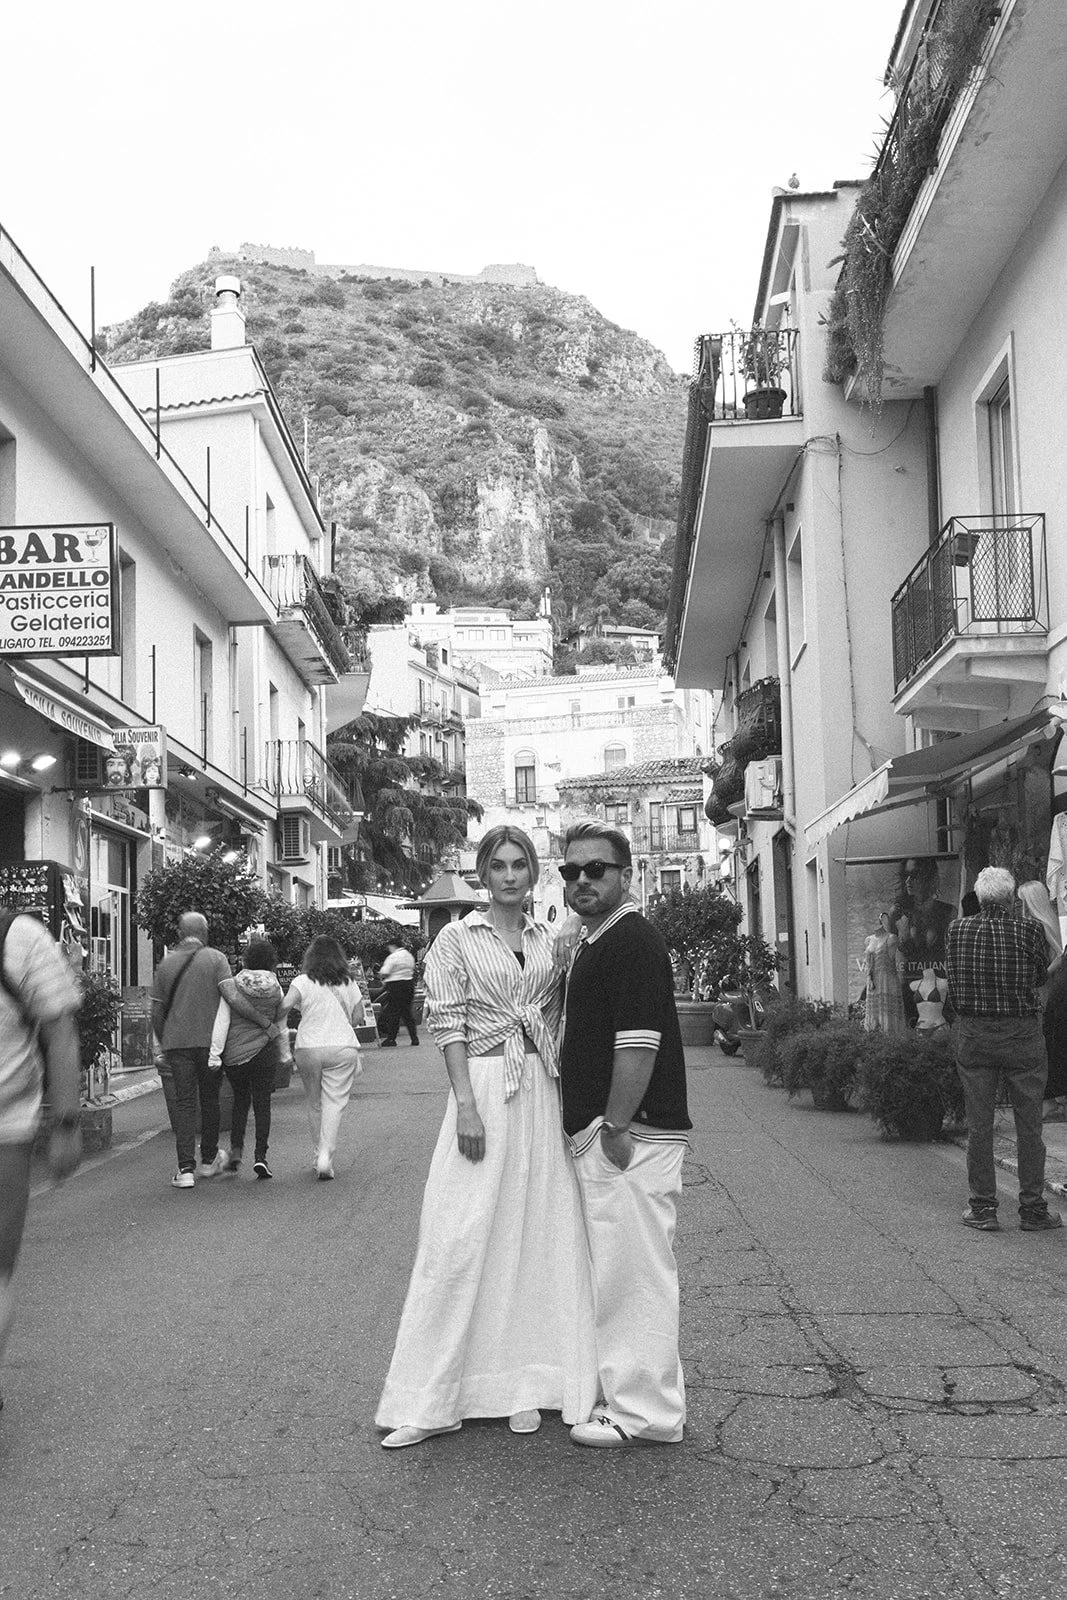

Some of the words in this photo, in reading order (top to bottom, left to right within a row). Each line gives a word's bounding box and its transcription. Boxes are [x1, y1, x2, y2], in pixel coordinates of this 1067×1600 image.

[0, 532, 84, 564] BAR
[10, 612, 109, 632] Gelateria
[39, 636, 56, 648] TEL.
[58, 634, 110, 648] 094223251
[25, 688, 56, 720] SICILIA
[61, 710, 104, 746] SOUVENIR
[128, 729, 159, 743] SOUVENIR
